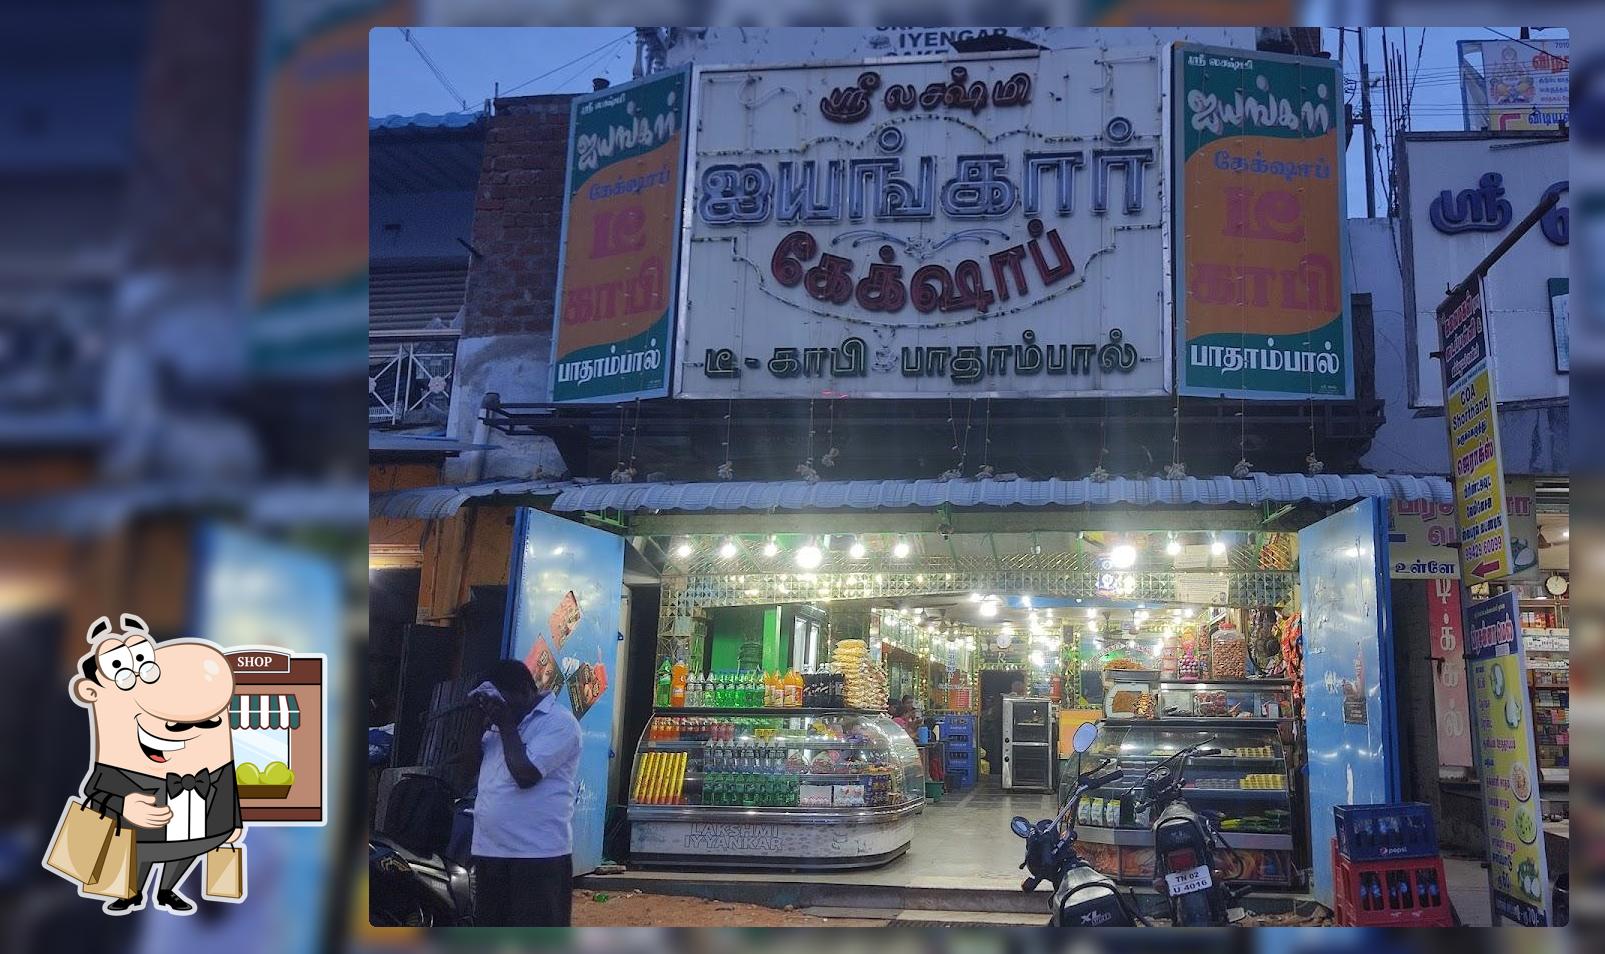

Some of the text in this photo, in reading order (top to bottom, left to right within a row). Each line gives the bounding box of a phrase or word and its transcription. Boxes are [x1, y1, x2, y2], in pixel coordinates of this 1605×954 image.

[819, 71, 882, 123] ஸ்ரீ
[699, 116, 1156, 226] ஐயங்கார்
[1429, 172, 1513, 235] ஸ்ரீ
[563, 255, 666, 326] காபி
[770, 218, 1076, 314] கேக்ஷாப்
[1190, 253, 1339, 313] காபி
[558, 338, 662, 387] பாதாம்பால்
[899, 327, 1139, 384] பாதாம்பால்
[1190, 337, 1340, 376] பாதாம்பால்
[1452, 393, 1489, 430] Shorthand
[1460, 383, 1476, 405] COA
[1395, 559, 1456, 574] உள்ளே
[690, 823, 779, 836] LAKSHMI
[1184, 879, 1207, 890] 4016
